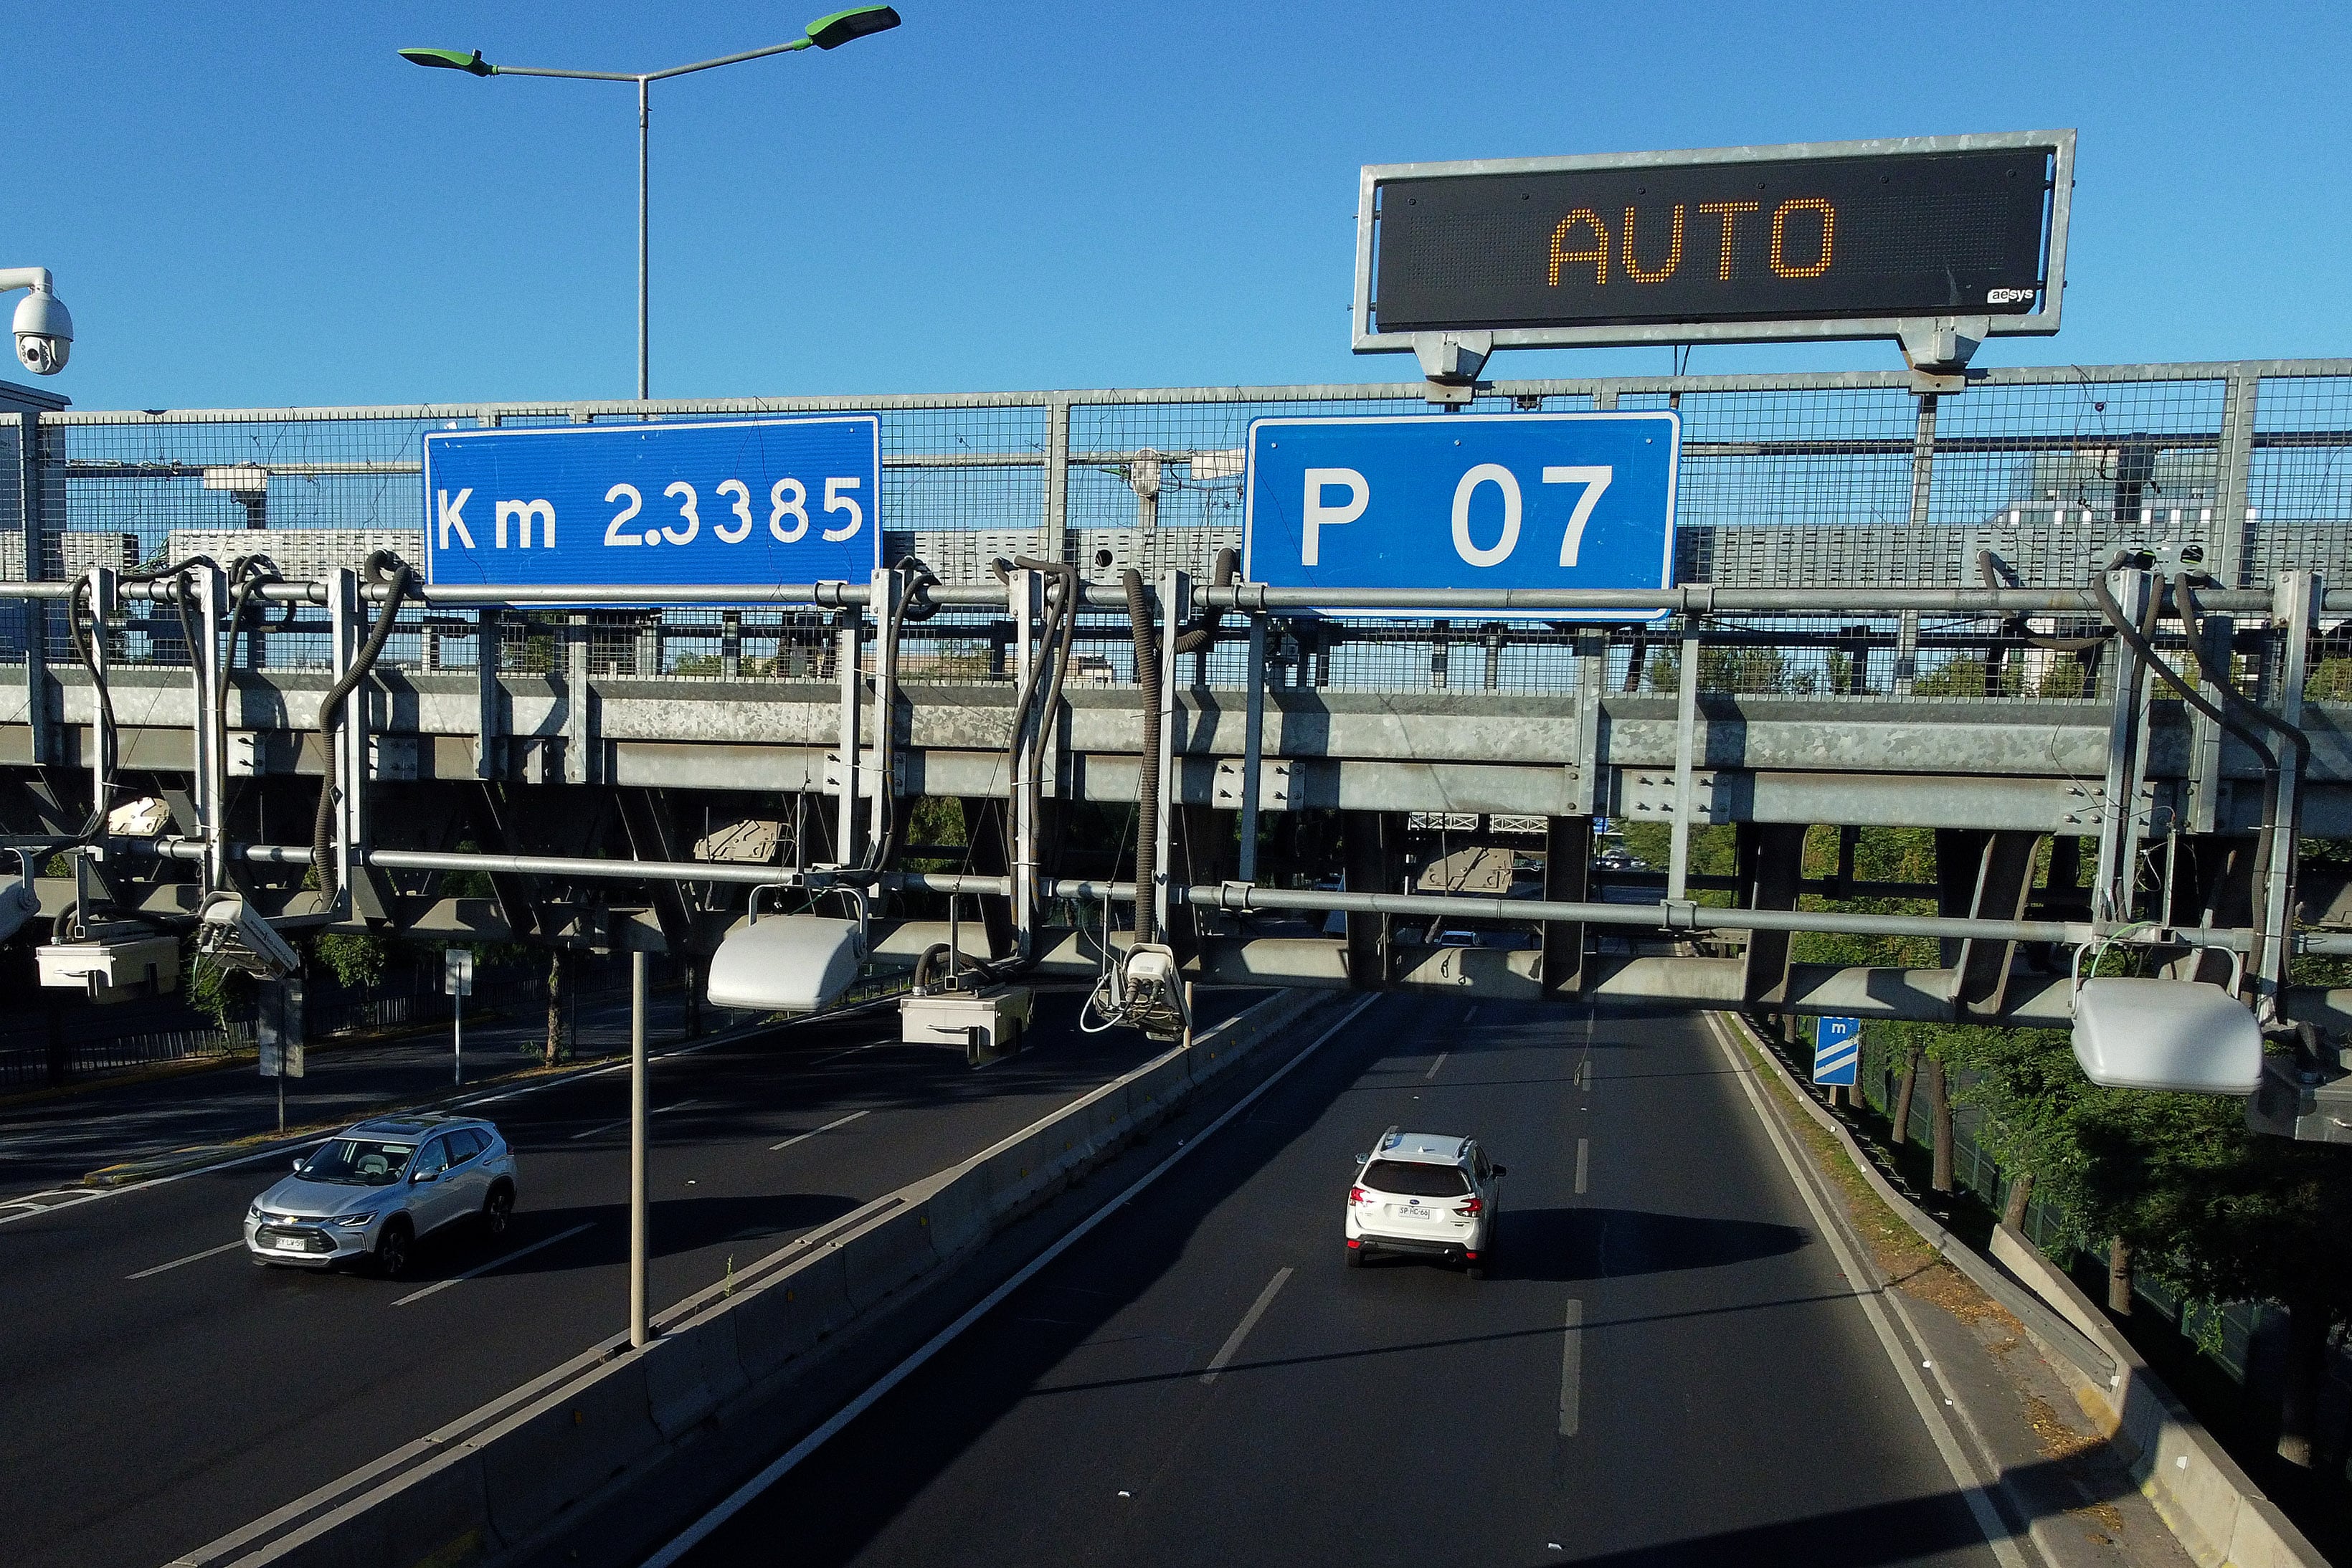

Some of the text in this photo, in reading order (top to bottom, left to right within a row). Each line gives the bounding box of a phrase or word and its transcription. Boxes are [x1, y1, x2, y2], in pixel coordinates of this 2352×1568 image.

[1547, 197, 1836, 287] AUTO
[1991, 288, 2034, 303] aesys
[603, 477, 863, 546] 2.3385
[1301, 463, 1613, 567] P 07
[1831, 1023, 1846, 1034] m
